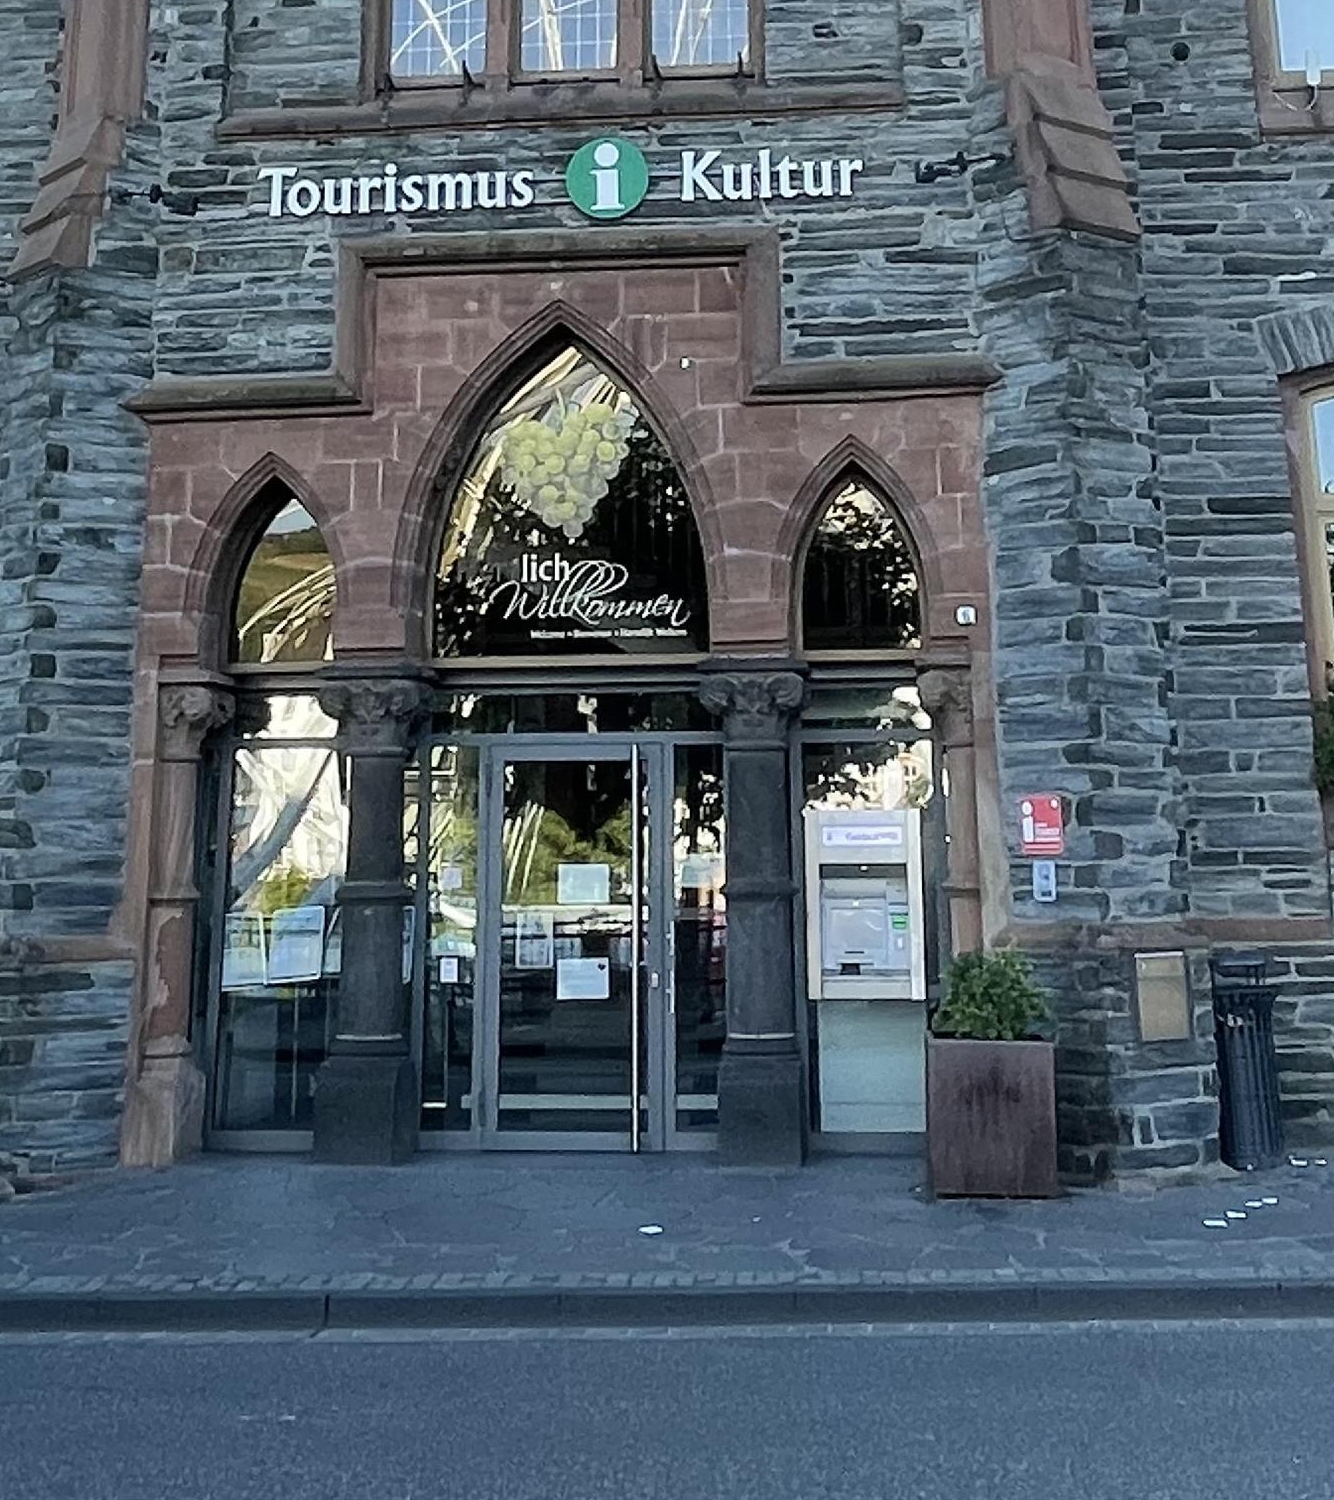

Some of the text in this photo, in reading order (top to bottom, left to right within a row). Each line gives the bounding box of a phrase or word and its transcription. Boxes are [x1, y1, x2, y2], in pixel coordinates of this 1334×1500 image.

[256, 162, 534, 217] Tourismus
[680, 149, 863, 201] Kultur
[480, 559, 692, 627] Willkommen
